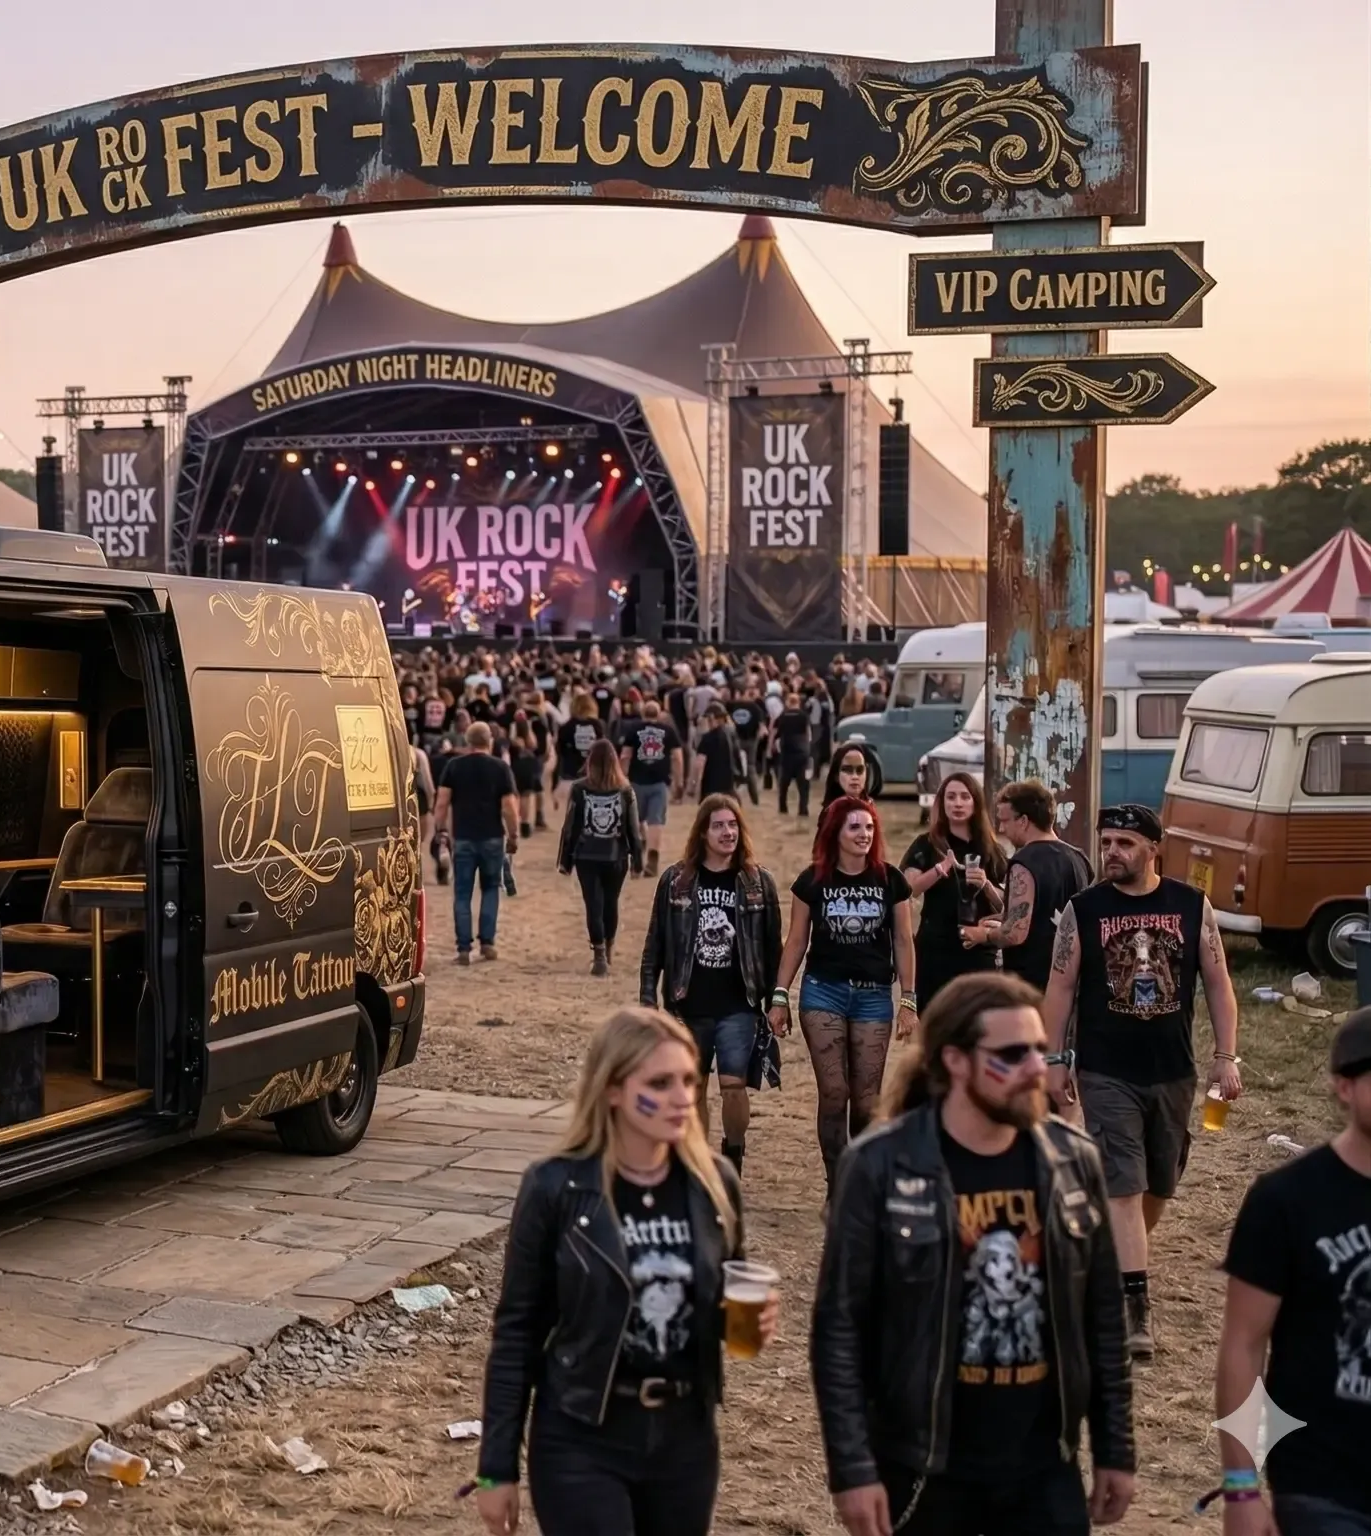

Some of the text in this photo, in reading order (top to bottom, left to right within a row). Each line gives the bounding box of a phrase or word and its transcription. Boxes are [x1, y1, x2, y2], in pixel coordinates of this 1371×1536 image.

[160, 92, 328, 198] FEST
[406, 76, 824, 179] WELCOME
[934, 270, 999, 314] VIP
[251, 353, 558, 412] SATURDAY NIGHT HEADLINERS
[762, 423, 810, 465] UK
[102, 452, 139, 487] UK
[741, 464, 833, 507] ROCK
[86, 487, 157, 524] ROCK
[92, 524, 150, 557] FEST
[406, 502, 598, 573] UK ROCK
[749, 508, 823, 547] FEST
[455, 560, 547, 606] FEST
[208, 954, 288, 1026] Mobile
